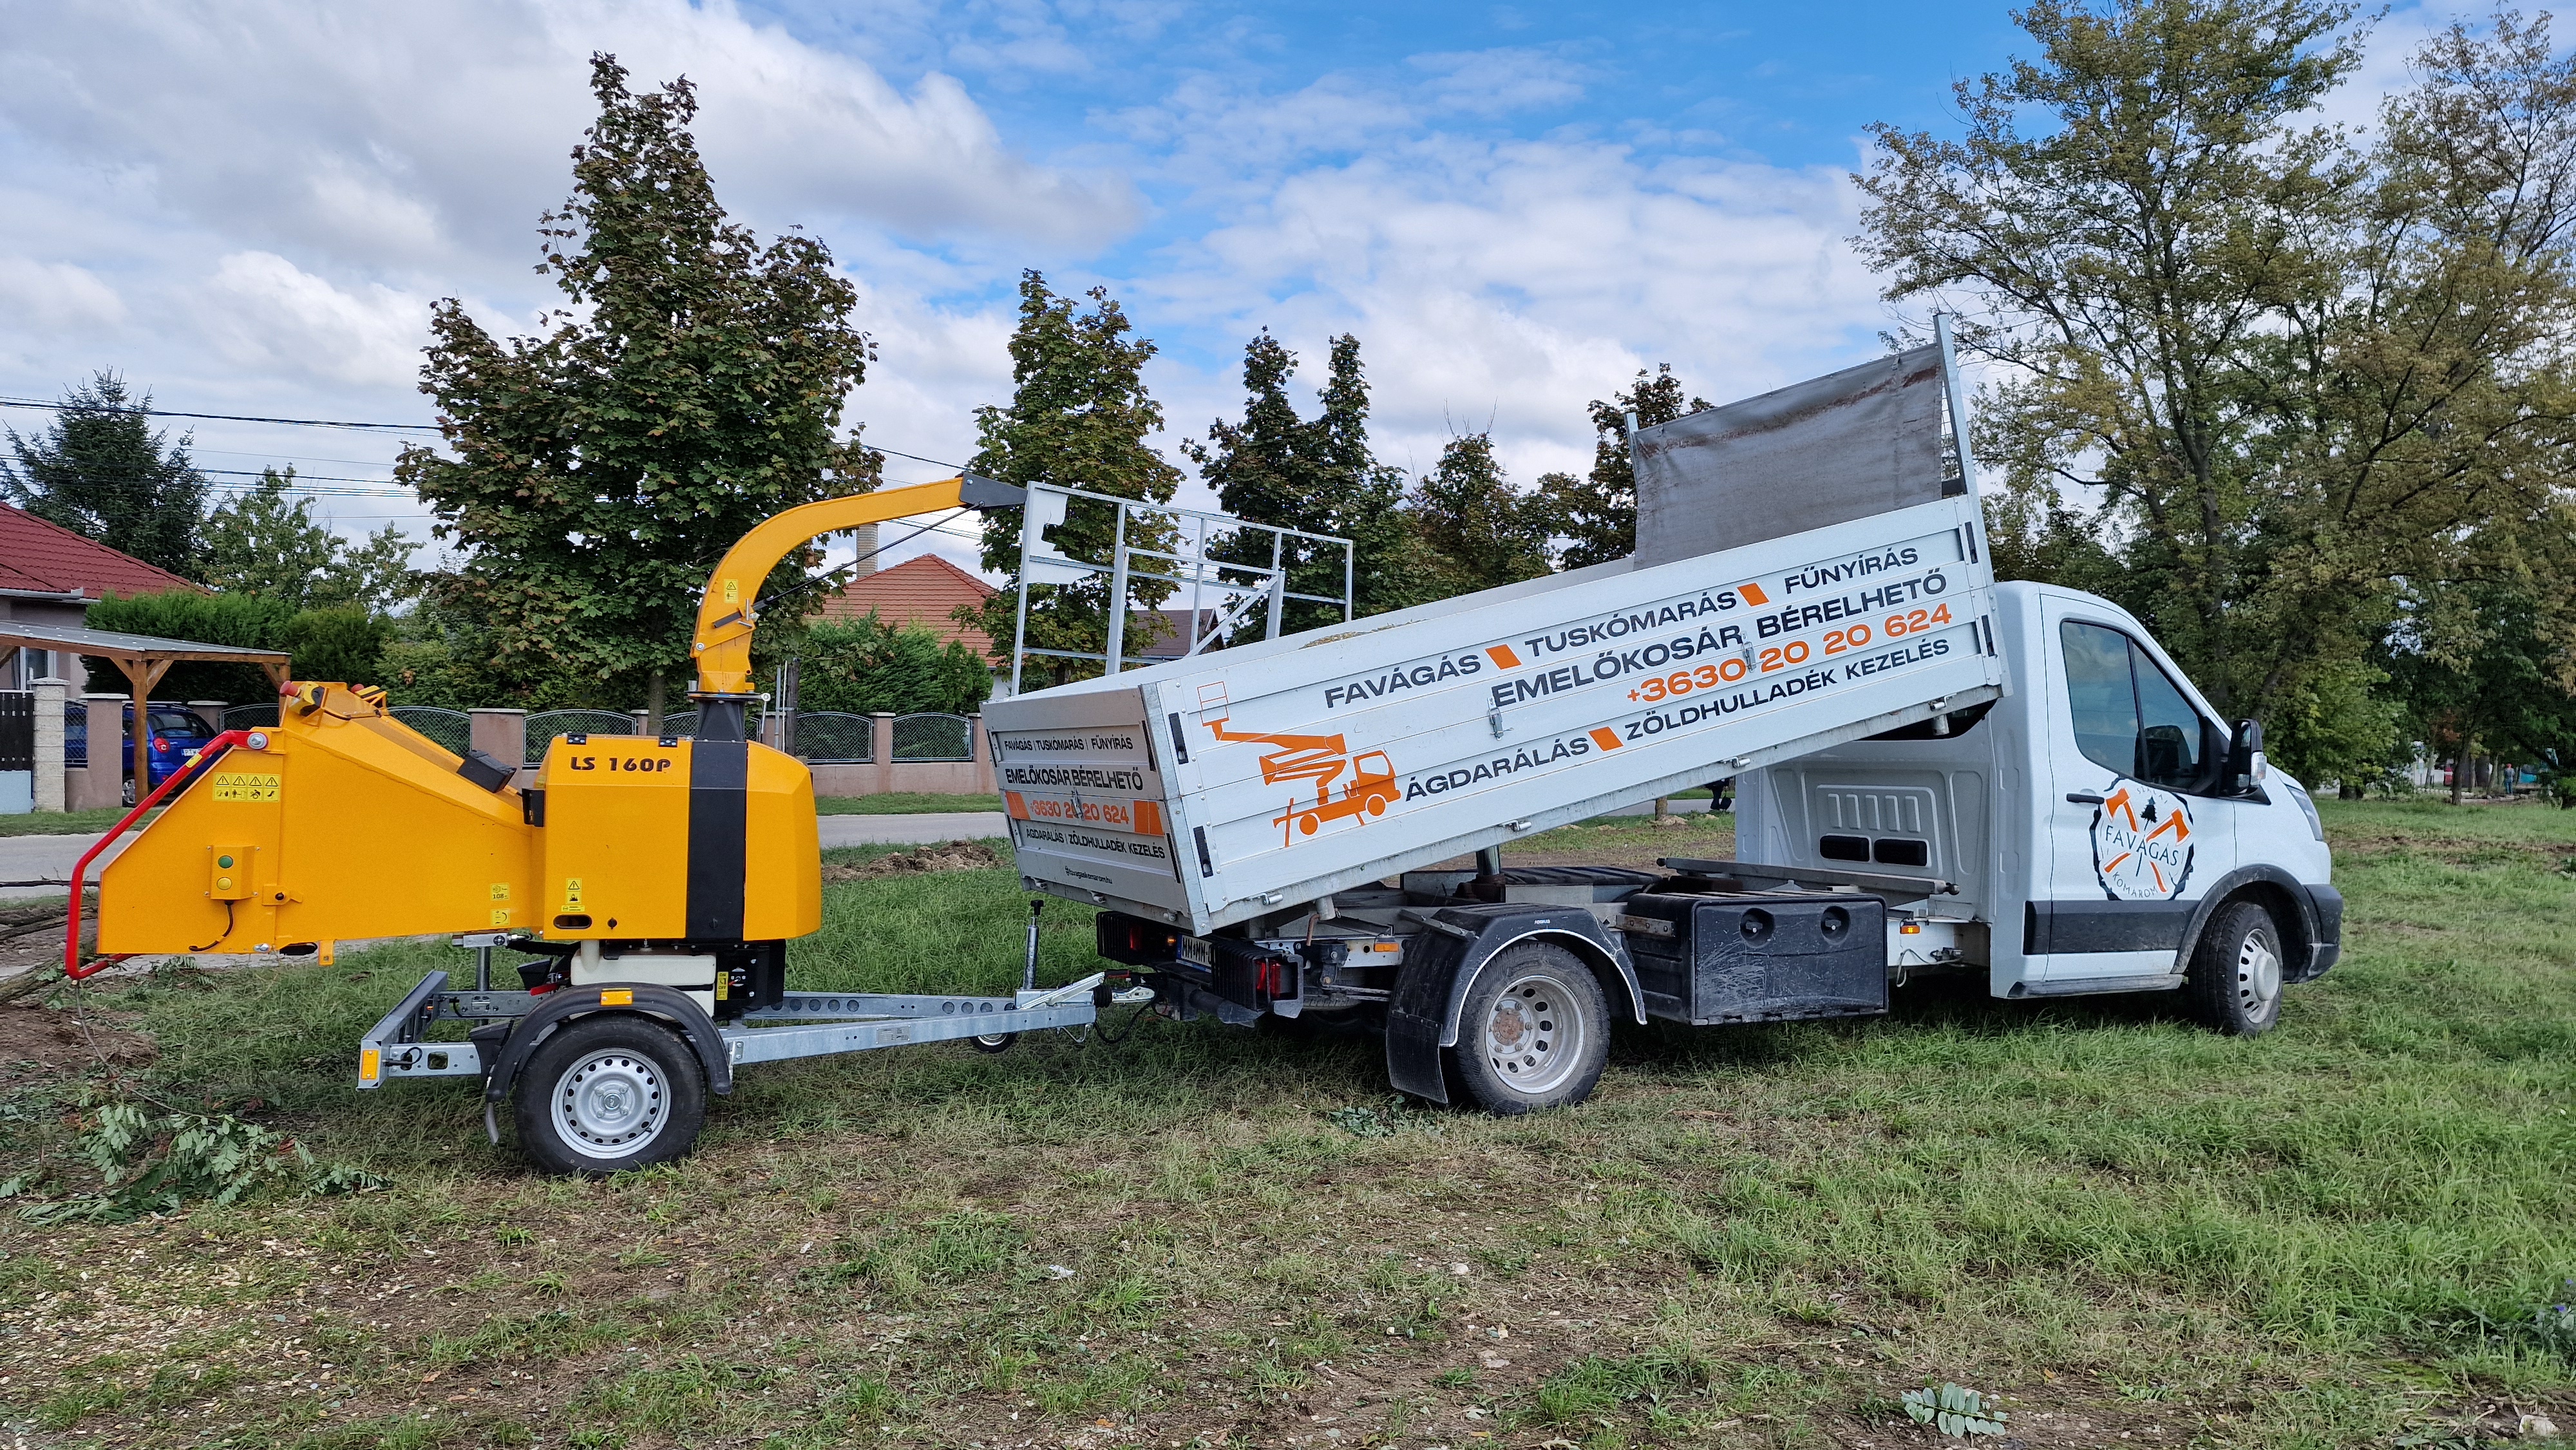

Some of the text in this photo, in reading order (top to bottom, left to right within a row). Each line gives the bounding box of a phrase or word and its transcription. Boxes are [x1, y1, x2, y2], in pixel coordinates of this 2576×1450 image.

[1325, 548, 1918, 708] FAVÁGÁS TUSKÓMARÁS FŰNYÍRÁS
[1492, 567, 1946, 707] EMELŐKOSÁR BÉRELHETŐ
[1627, 603, 1953, 702] +3630 20 20 624
[1406, 638, 1949, 802] ÁGDARÁLÁS ZÖLDHULLADÉK KEZELÉS
[1004, 734, 1133, 751] FAVÁGÁS TUSKÓMARÁS FŰNYÍRÁS
[570, 756, 671, 772] LS 160P
[1005, 765, 1144, 791] EMELŐKOSÁR BÉRELHETŐ
[1082, 803, 1100, 821] 20
[1103, 804, 1130, 825] 624
[1027, 825, 1166, 859] ÁGDARÁLÁS ZÖLDHULLADÉK KEZELÉS
[2105, 825, 2179, 866] FAVÁGÁS
